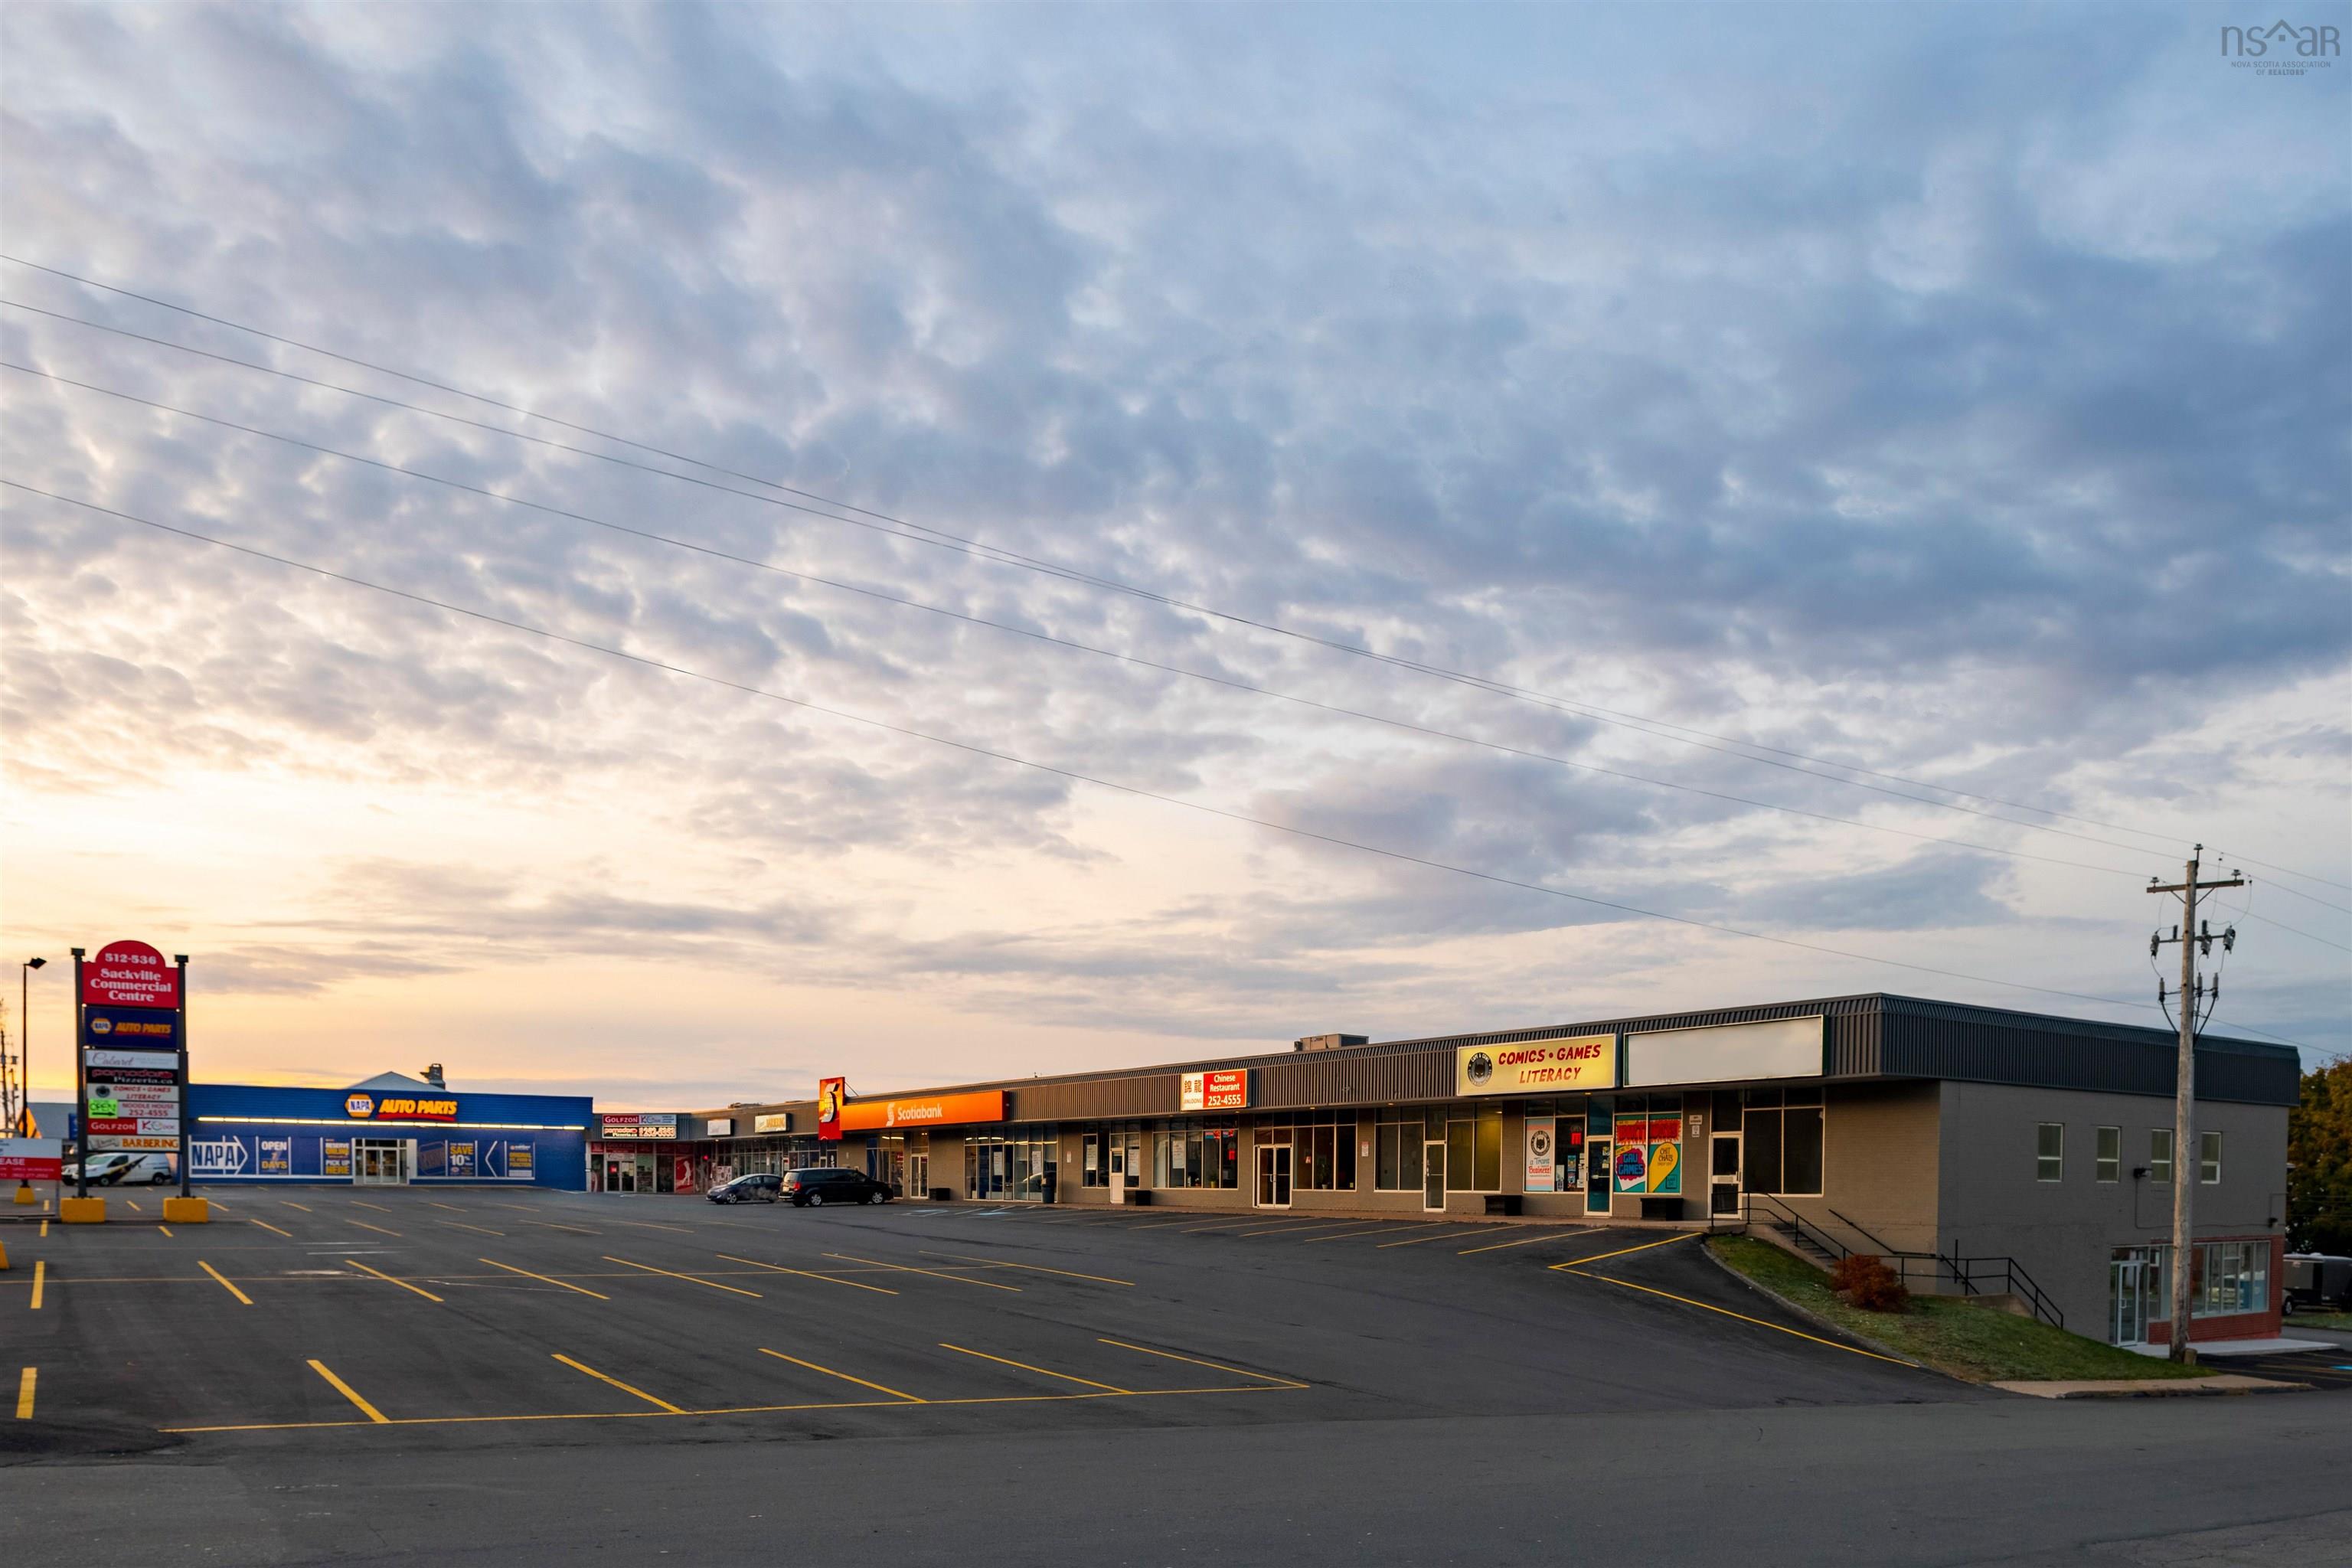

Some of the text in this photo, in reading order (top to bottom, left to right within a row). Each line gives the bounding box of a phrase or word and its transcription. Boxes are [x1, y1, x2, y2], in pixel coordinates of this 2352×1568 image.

[105, 952, 156, 965] 512-536
[100, 969, 161, 981] Sackville
[90, 978, 172, 992] Commercial
[109, 990, 155, 1001] Centre
[116, 1022, 141, 1032] AUTO
[142, 1023, 172, 1034] PARTS
[1498, 1044, 1601, 1065] COMICS GAMES
[1214, 1074, 1236, 1083] Chinese
[1519, 1067, 1581, 1084] LITERACY
[1210, 1083, 1240, 1093] Restaurant
[1208, 1094, 1241, 1106] 252-4555
[351, 1099, 458, 1115] NAPA AUTO PARTS
[897, 1103, 942, 1120] Scotiabank
[91, 1122, 136, 1130] GOLFZON
[122, 1138, 178, 1148] BARBERING
[261, 1141, 287, 1151] OPEN
[192, 1145, 236, 1167] NAPA
[450, 1146, 473, 1155] SAVE
[261, 1161, 287, 1169] DAYS
[1528, 1165, 1551, 1174] Business!
[1619, 1164, 1643, 1174] GAMES
